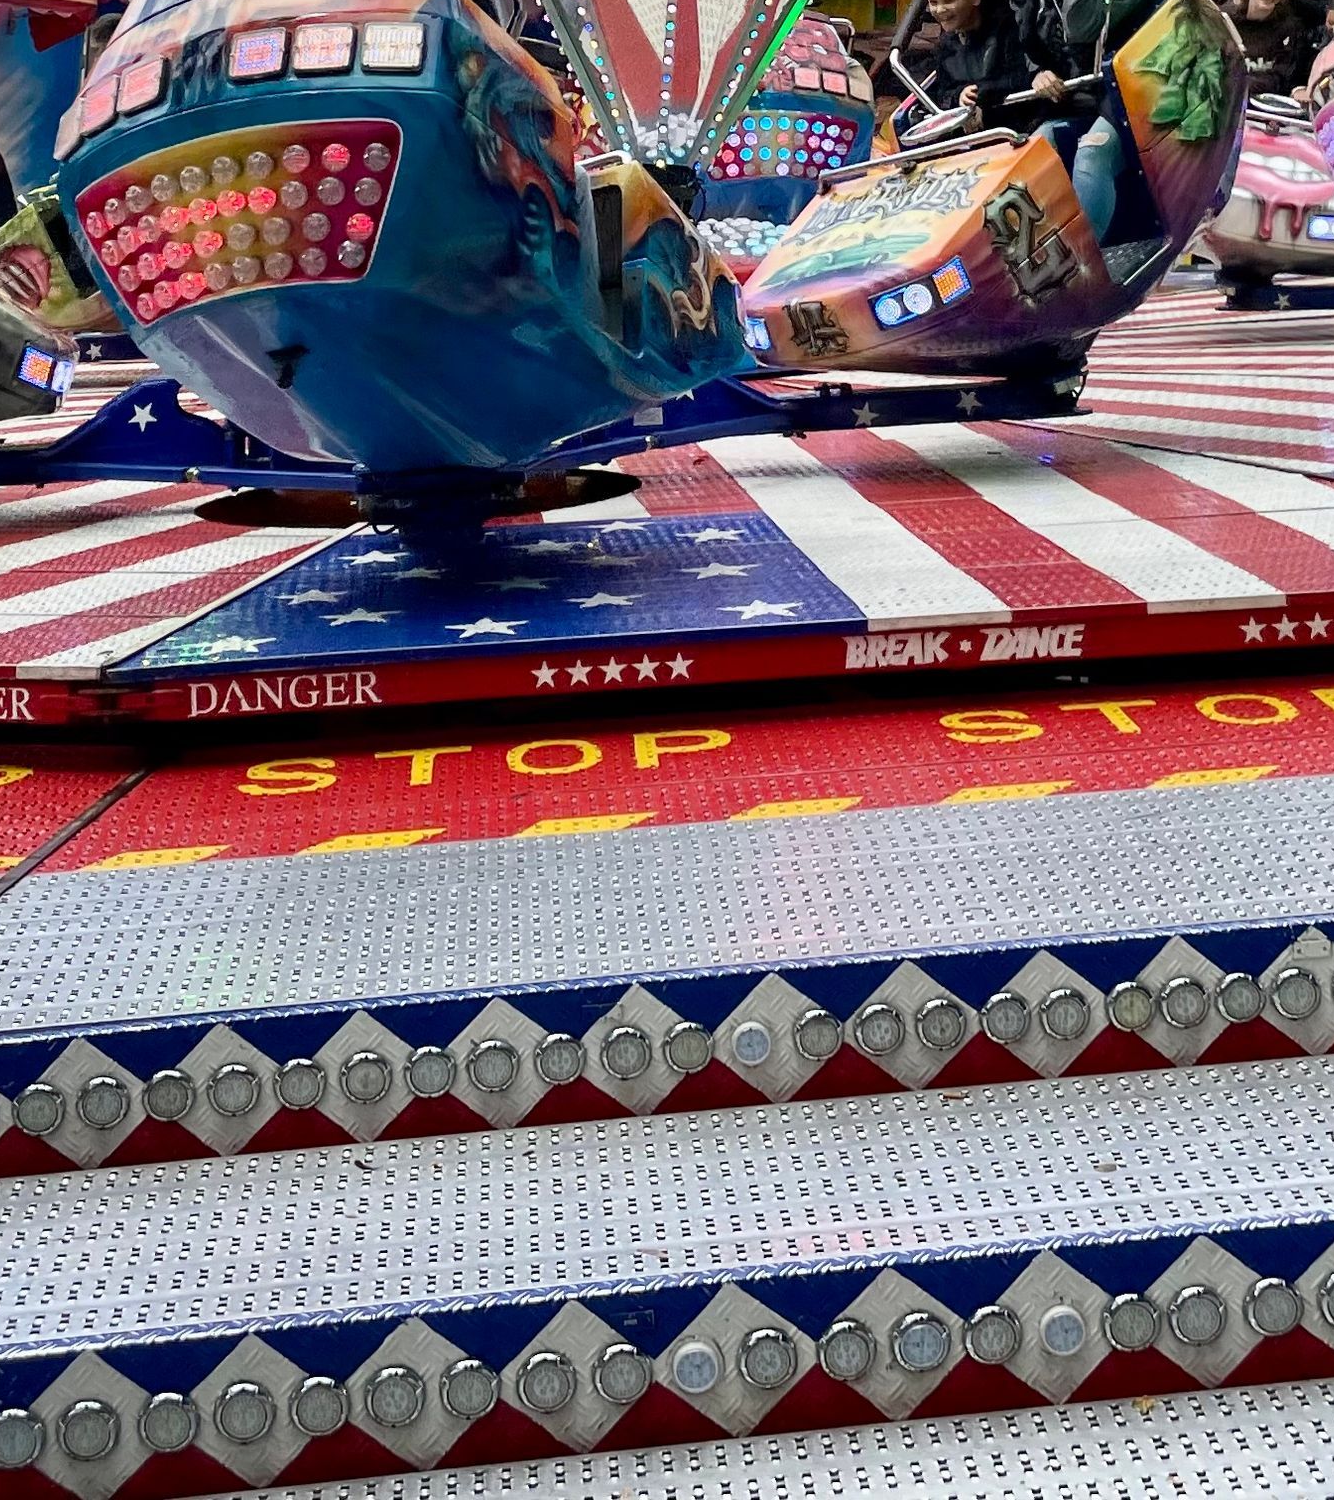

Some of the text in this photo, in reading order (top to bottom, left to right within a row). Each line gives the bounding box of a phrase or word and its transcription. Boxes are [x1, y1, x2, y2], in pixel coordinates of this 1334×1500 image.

[842, 622, 1087, 670] BREAK DANCE
[187, 670, 384, 719] DANGER
[235, 728, 734, 796] STOP
